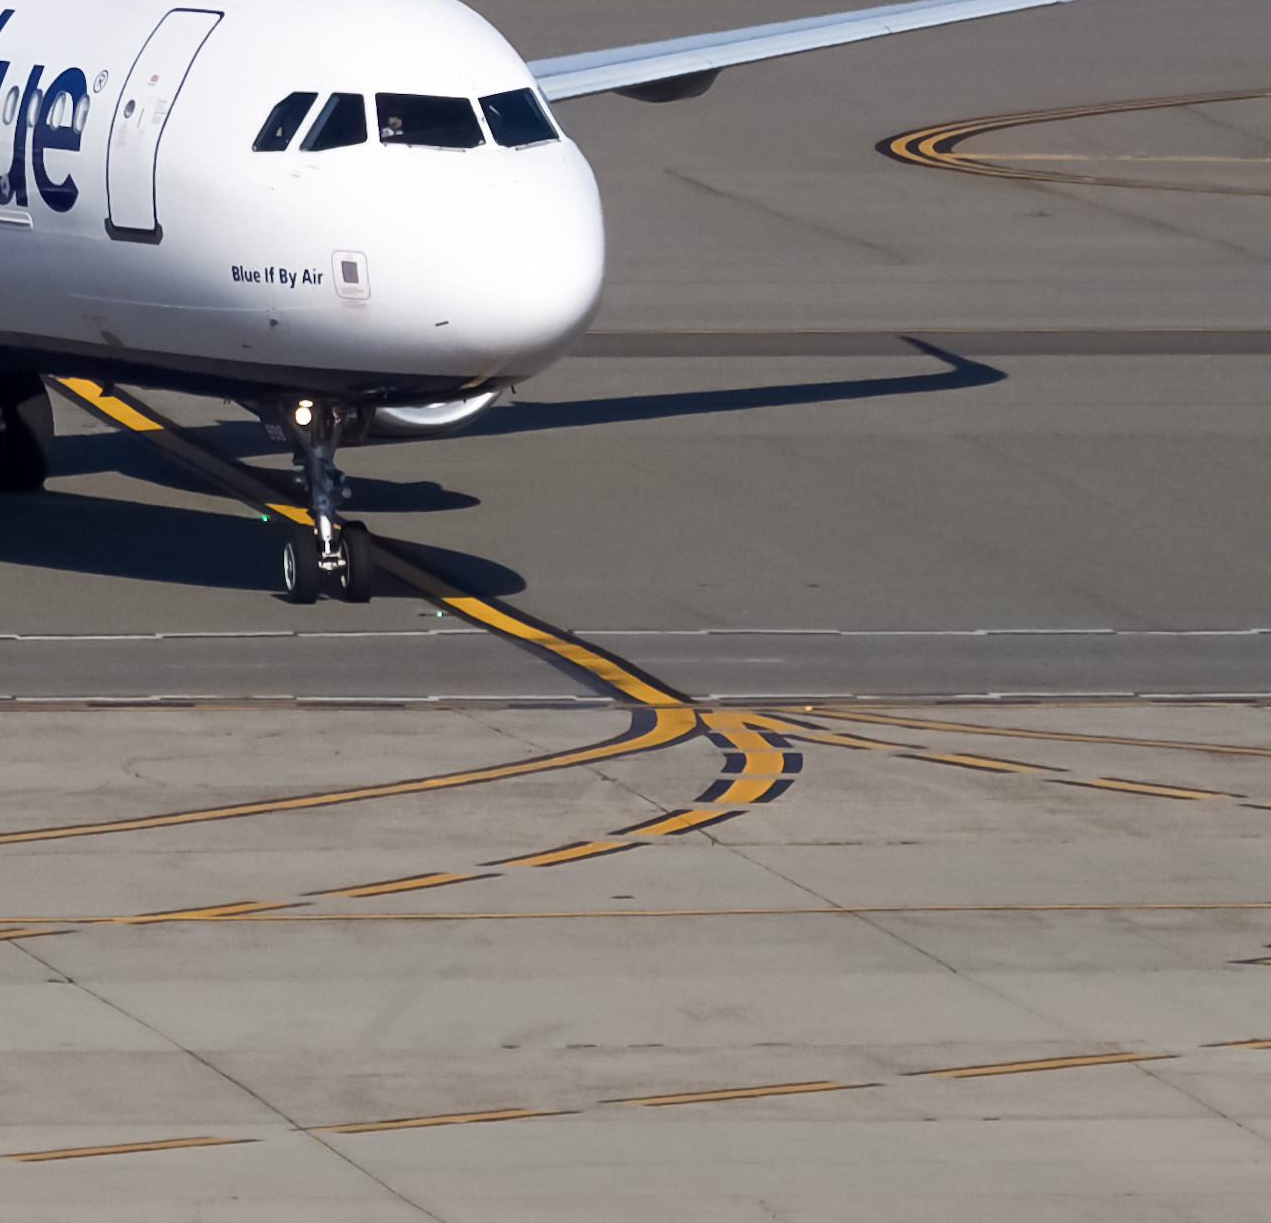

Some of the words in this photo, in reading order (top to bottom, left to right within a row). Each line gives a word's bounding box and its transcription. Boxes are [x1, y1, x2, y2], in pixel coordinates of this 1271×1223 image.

[232, 265, 261, 283] Blue
[265, 267, 275, 284] If
[279, 268, 297, 288] By
[302, 268, 324, 285] Air
